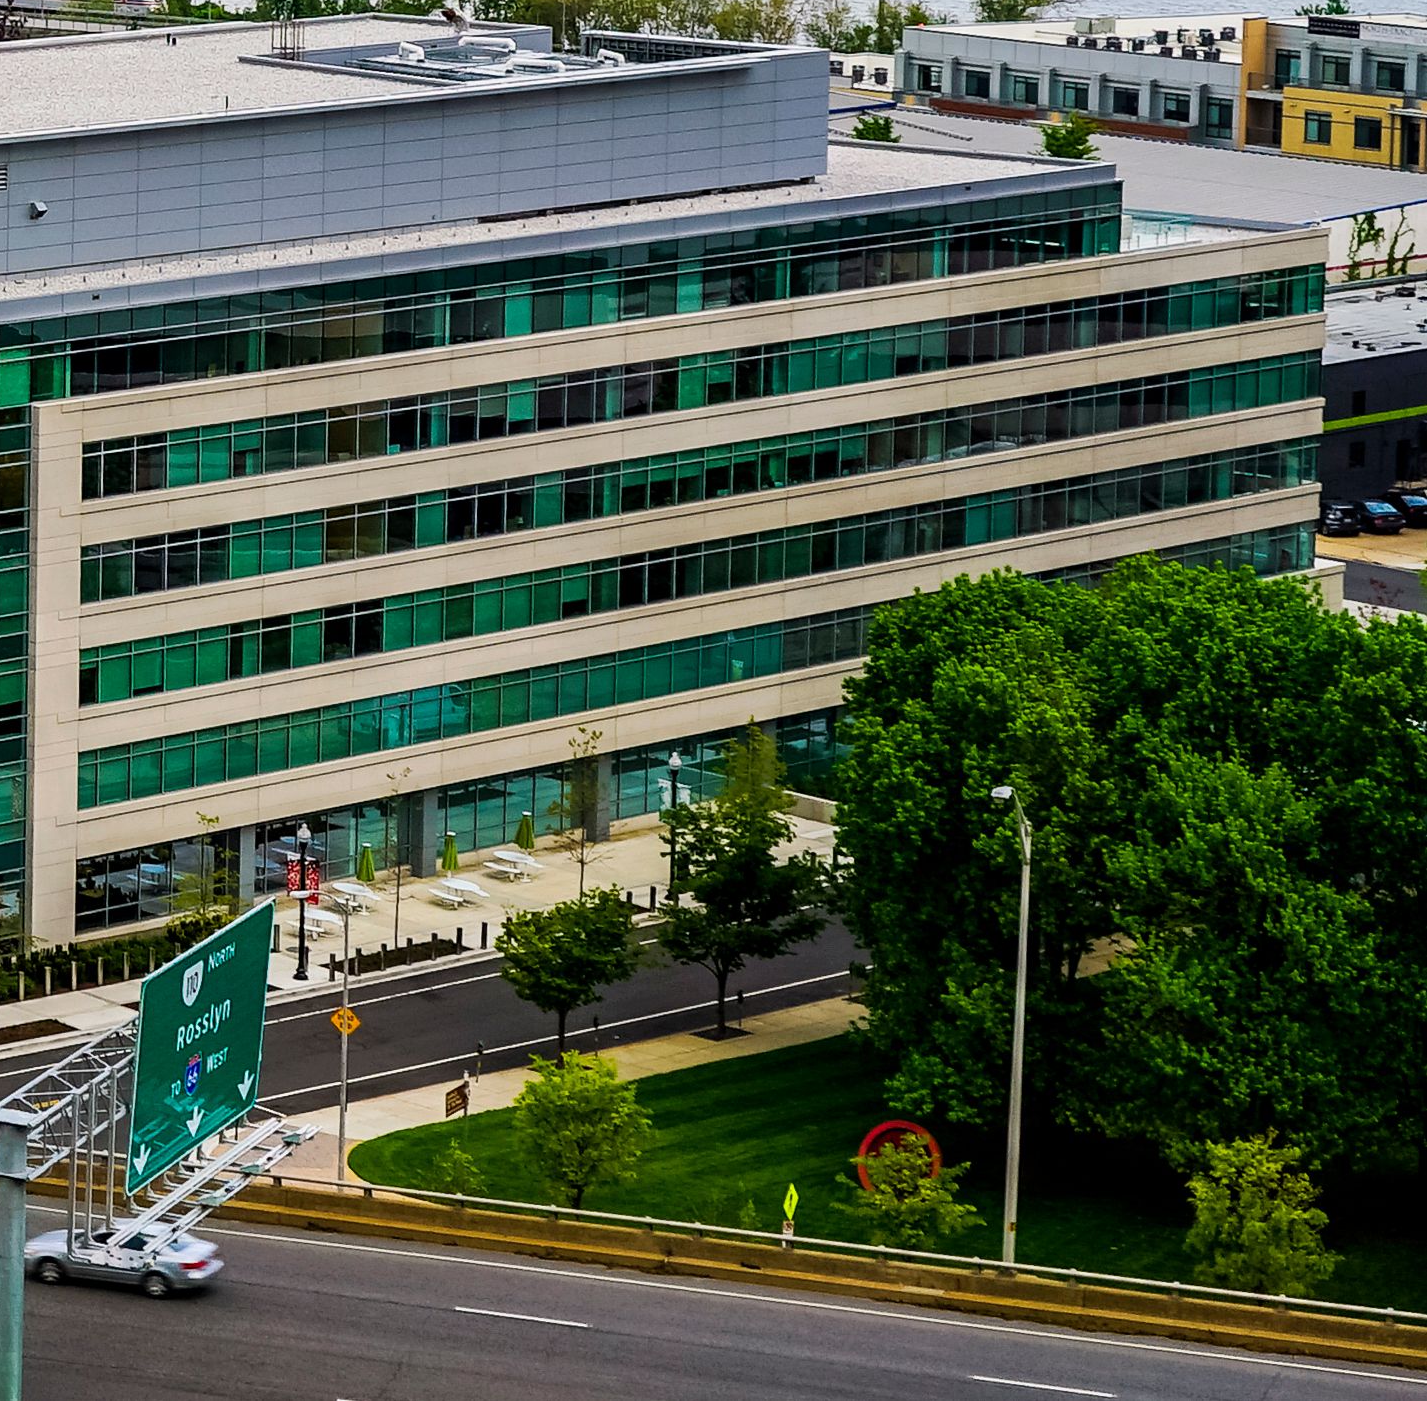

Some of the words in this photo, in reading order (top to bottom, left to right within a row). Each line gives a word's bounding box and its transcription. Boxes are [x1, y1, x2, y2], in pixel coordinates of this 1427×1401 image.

[186, 972, 199, 998] 110
[207, 942, 236, 973] NORTH
[176, 999, 231, 1052] Rosslyn
[171, 1080, 182, 1099] TO
[187, 1066, 198, 1087] 66
[206, 1046, 229, 1074] WEST
